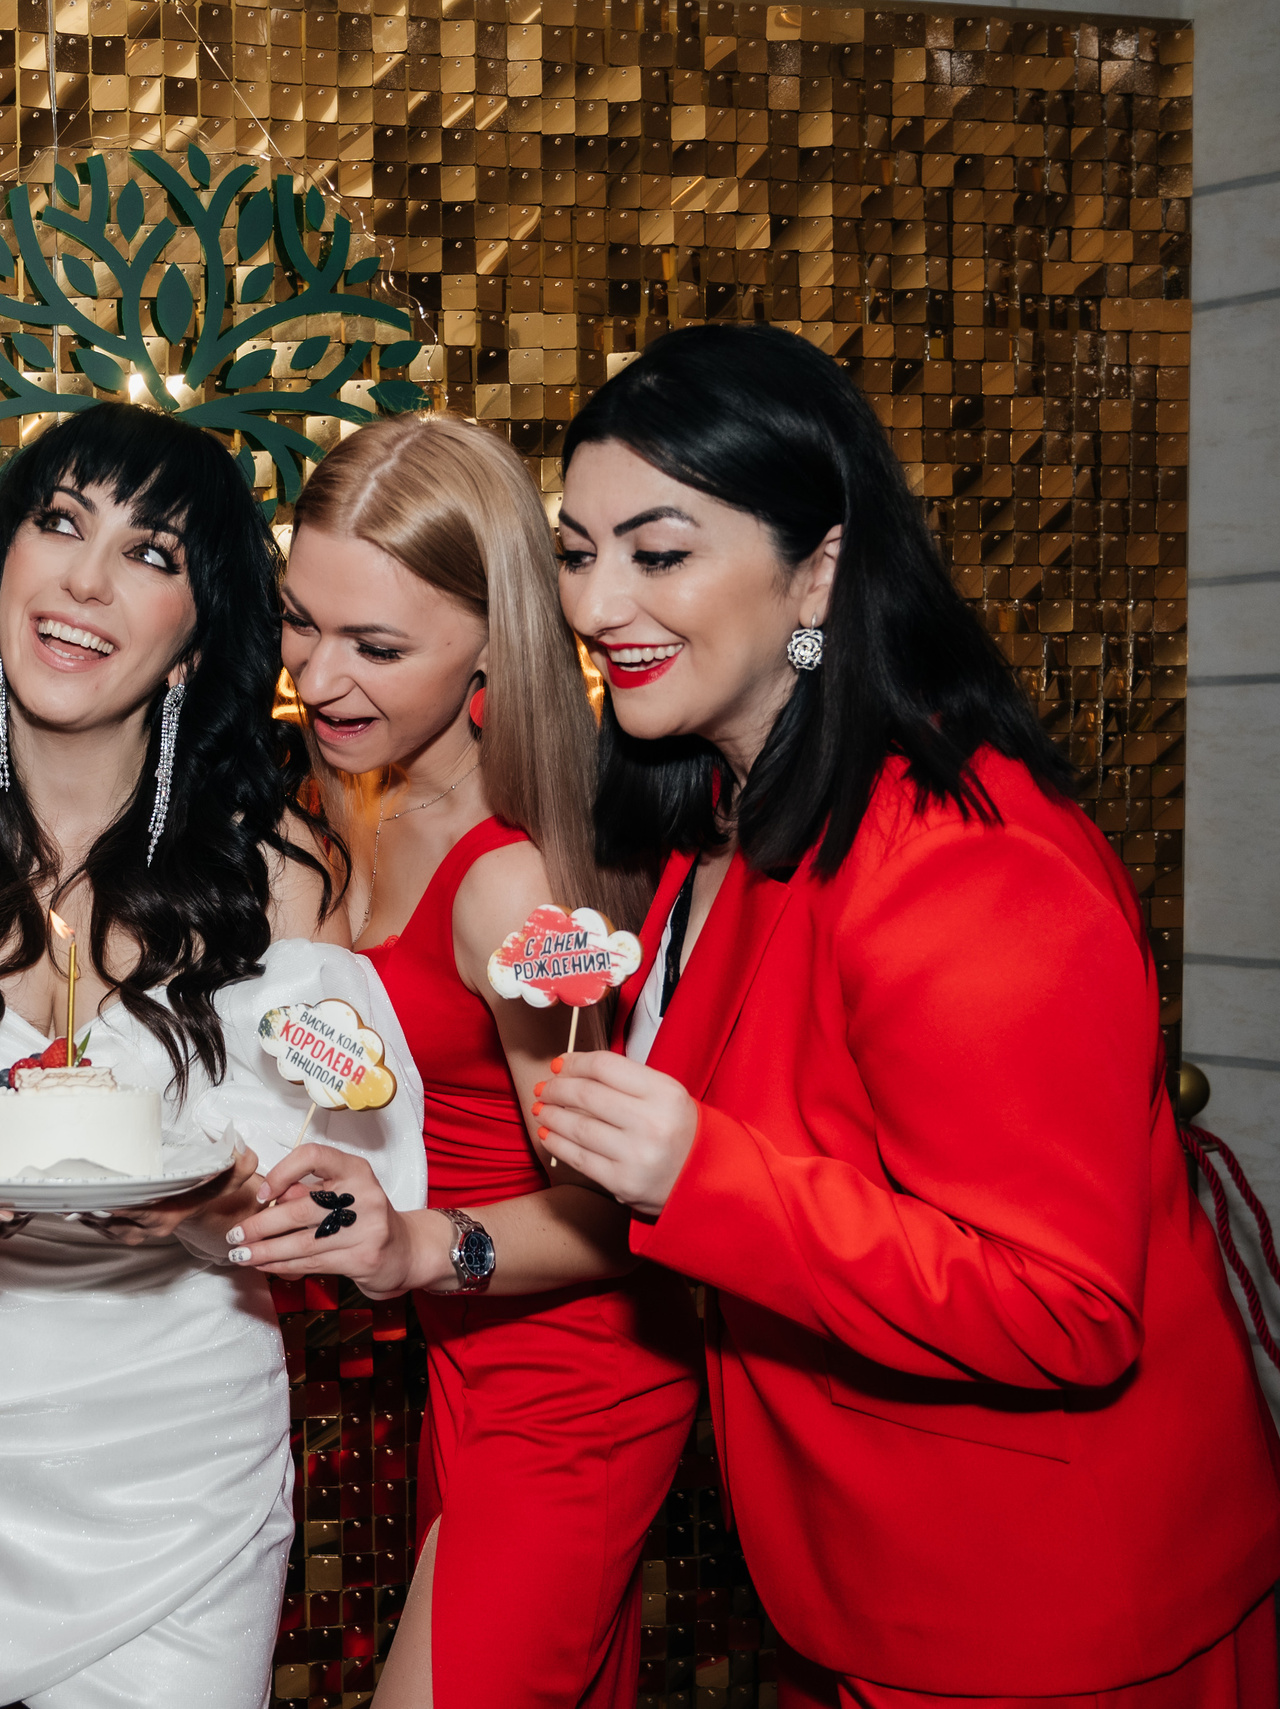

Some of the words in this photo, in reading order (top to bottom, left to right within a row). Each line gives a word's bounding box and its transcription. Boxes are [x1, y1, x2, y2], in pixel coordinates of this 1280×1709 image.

[525, 938, 536, 957] С
[540, 931, 589, 957] ДНЕМ
[514, 952, 612, 981] РОЖДЕНИЯ!
[280, 1020, 366, 1086] КОРОЛЕВА
[285, 1047, 344, 1093] ТАНЦПОЛА
